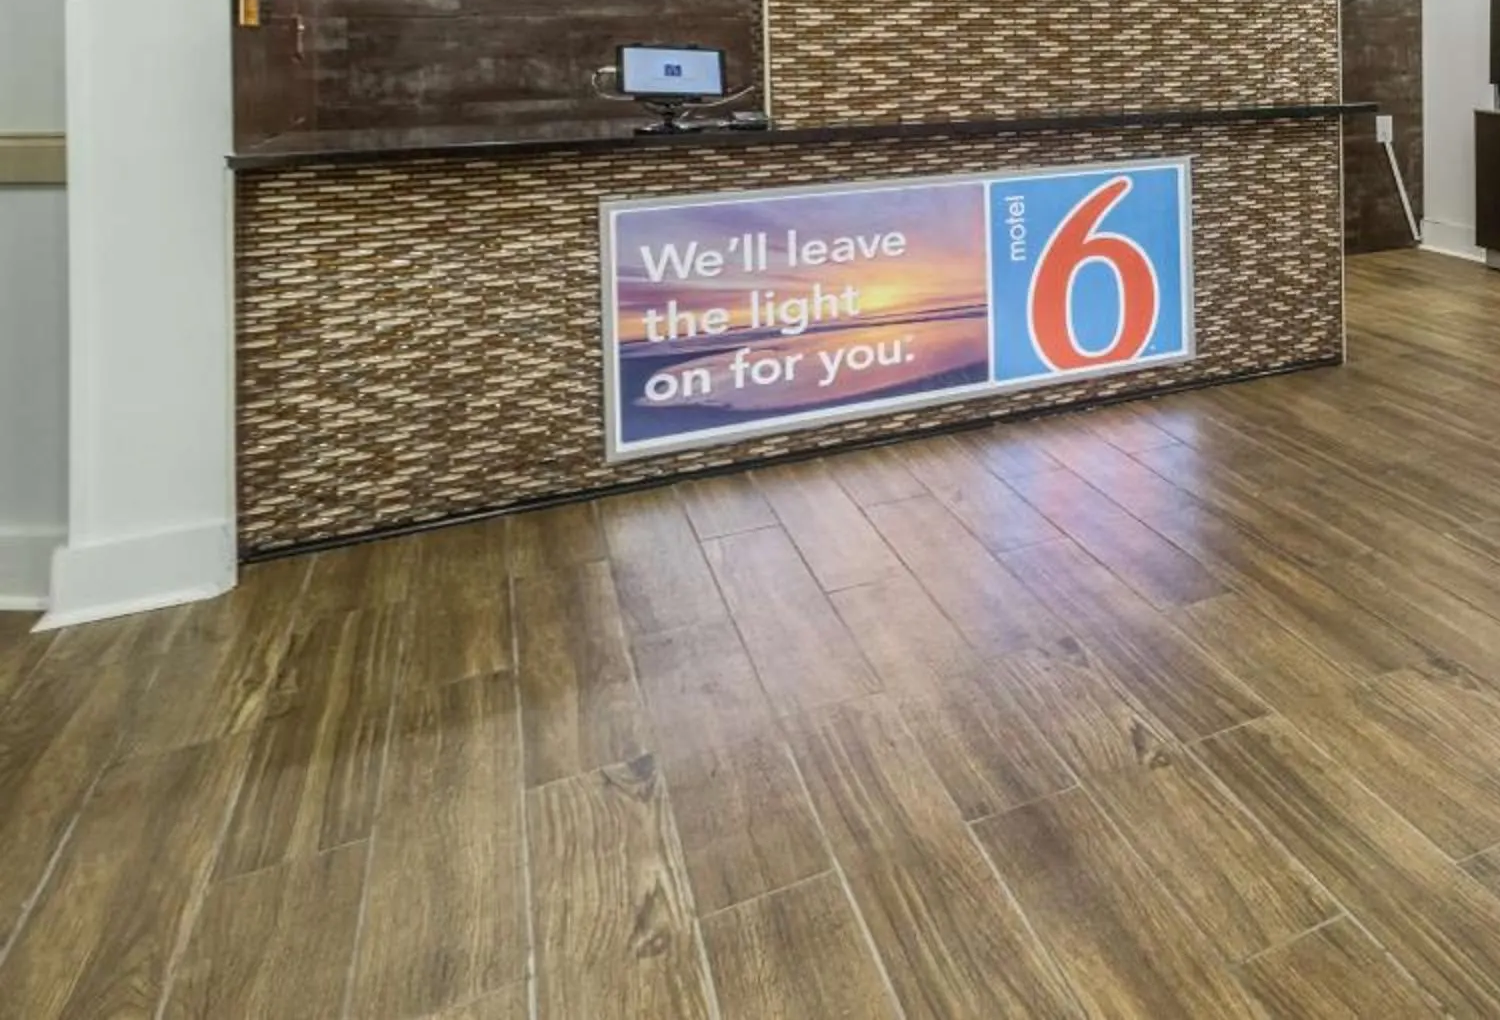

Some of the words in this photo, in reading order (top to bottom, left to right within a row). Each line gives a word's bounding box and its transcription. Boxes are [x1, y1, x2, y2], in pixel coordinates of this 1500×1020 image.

[640, 231, 767, 282] We'll
[787, 229, 907, 268] leave
[1004, 194, 1026, 261] motel
[1026, 175, 1160, 373] 6
[642, 299, 730, 343] the
[750, 283, 862, 335] light
[644, 367, 711, 401] on
[729, 347, 803, 389] for
